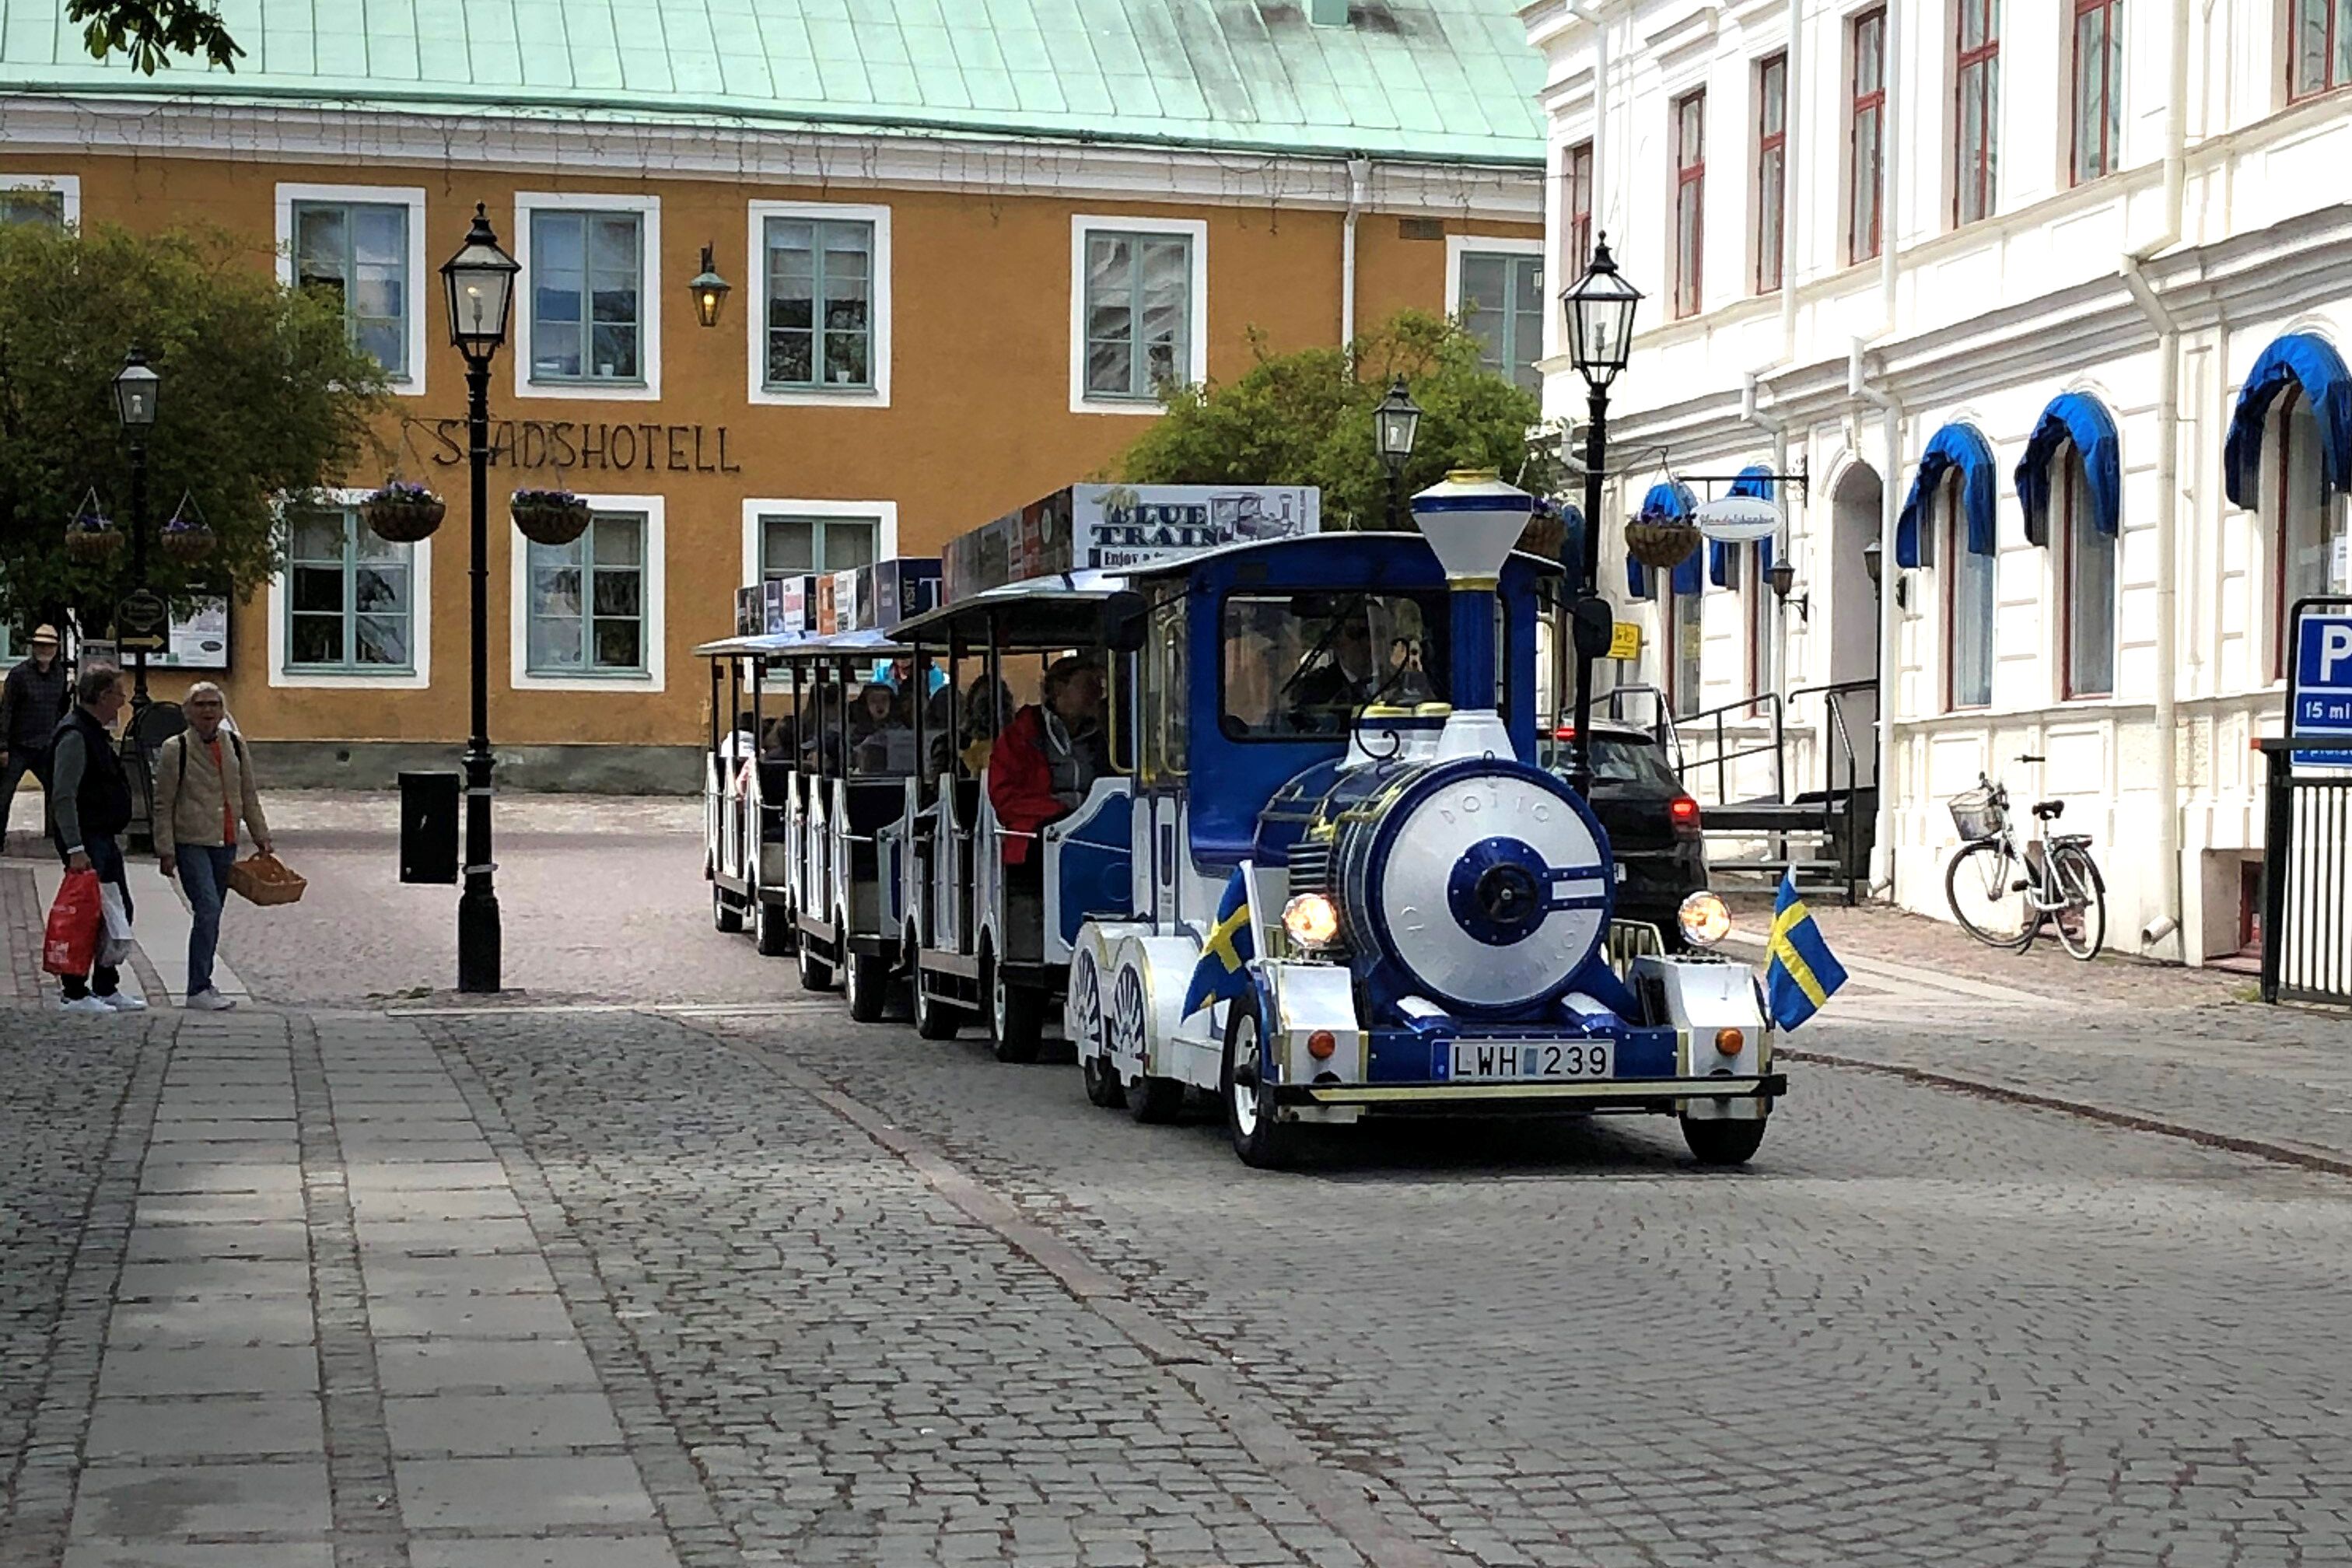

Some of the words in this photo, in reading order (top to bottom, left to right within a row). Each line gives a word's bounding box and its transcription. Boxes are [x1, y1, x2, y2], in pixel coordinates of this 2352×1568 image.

[432, 420, 740, 473] SADSHOTELL
[1105, 503, 1207, 524] BLUE
[1090, 523, 1220, 548] TRAIN
[2319, 625, 2352, 682] P
[2305, 700, 2323, 719] 15
[1454, 1046, 1517, 1076] LWH
[1543, 1045, 1607, 1076] 239
